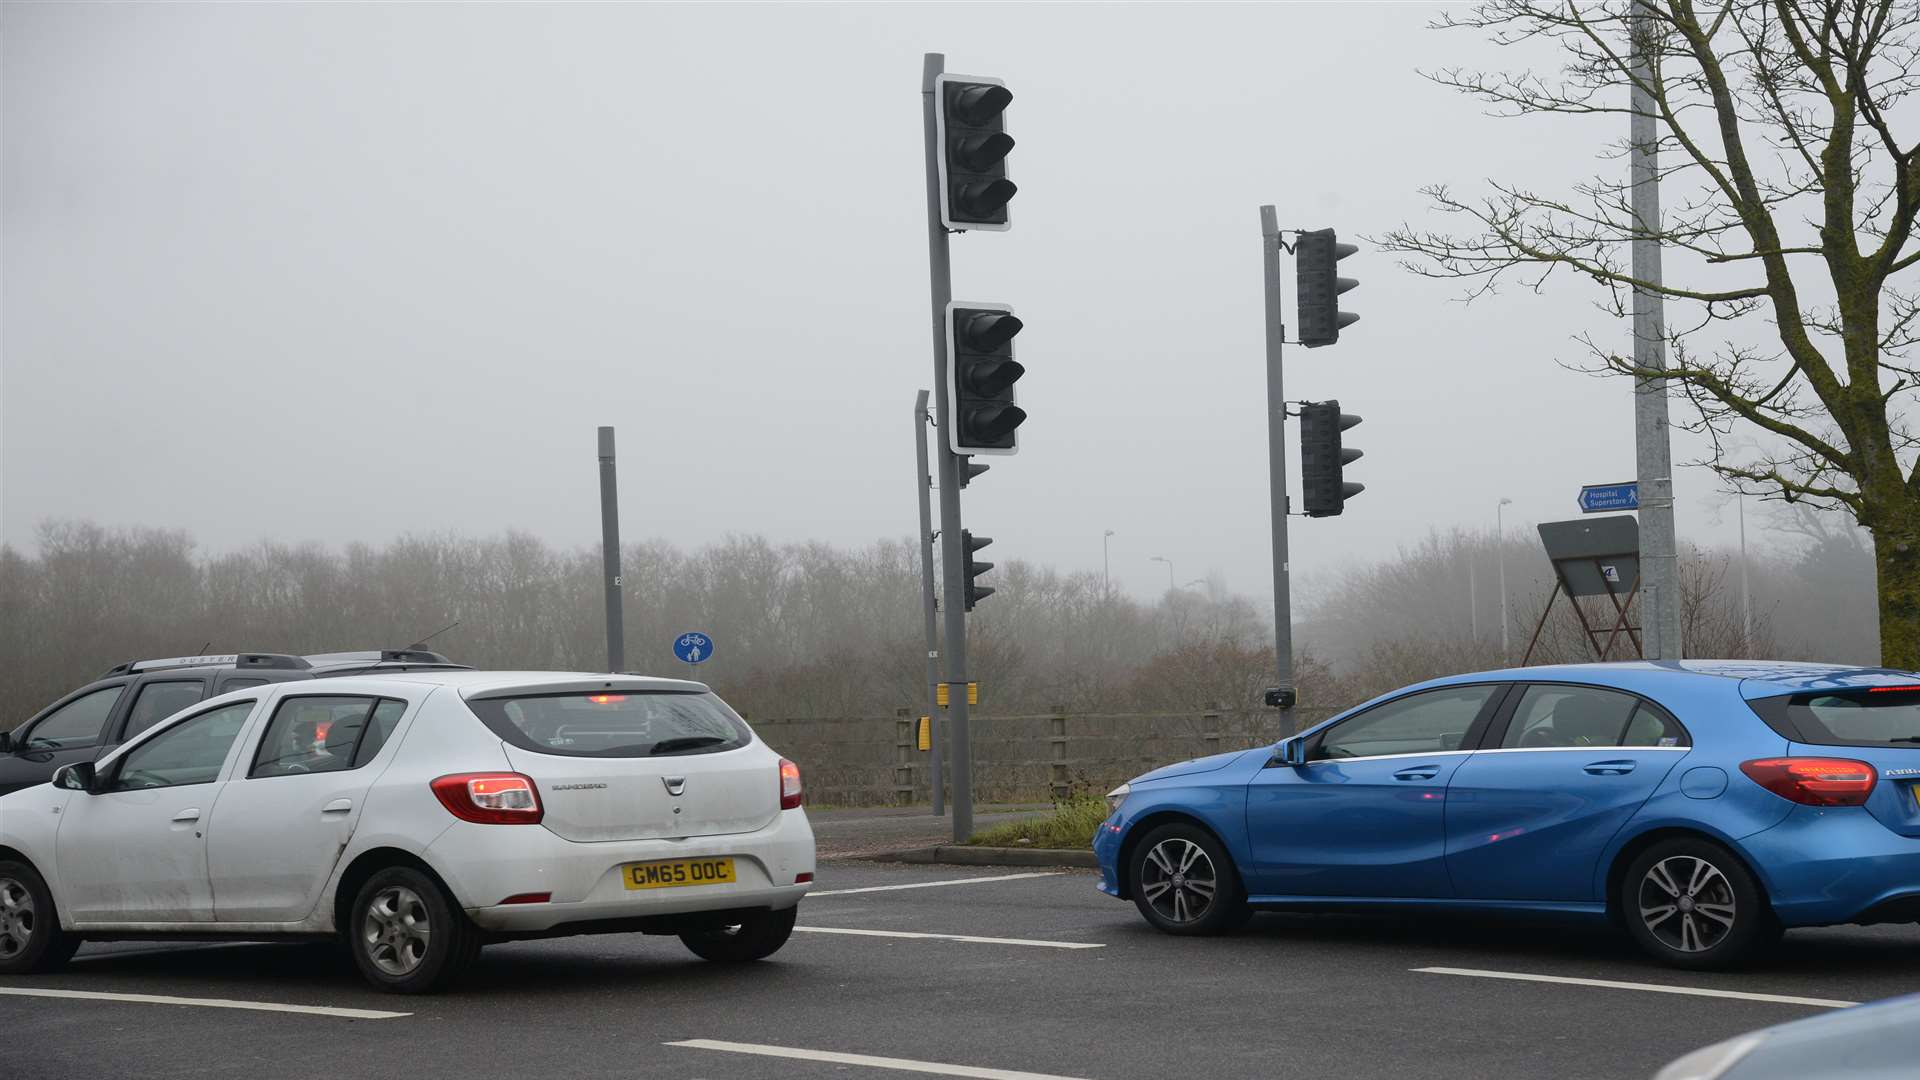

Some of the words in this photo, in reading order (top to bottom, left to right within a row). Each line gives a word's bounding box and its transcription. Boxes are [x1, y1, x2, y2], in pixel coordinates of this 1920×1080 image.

[1590, 490, 1617, 498] Hospital
[1590, 498, 1626, 506] Superstore
[552, 783, 608, 791] SANDERO
[632, 864, 685, 884] GM65
[691, 862, 728, 880] OOC
